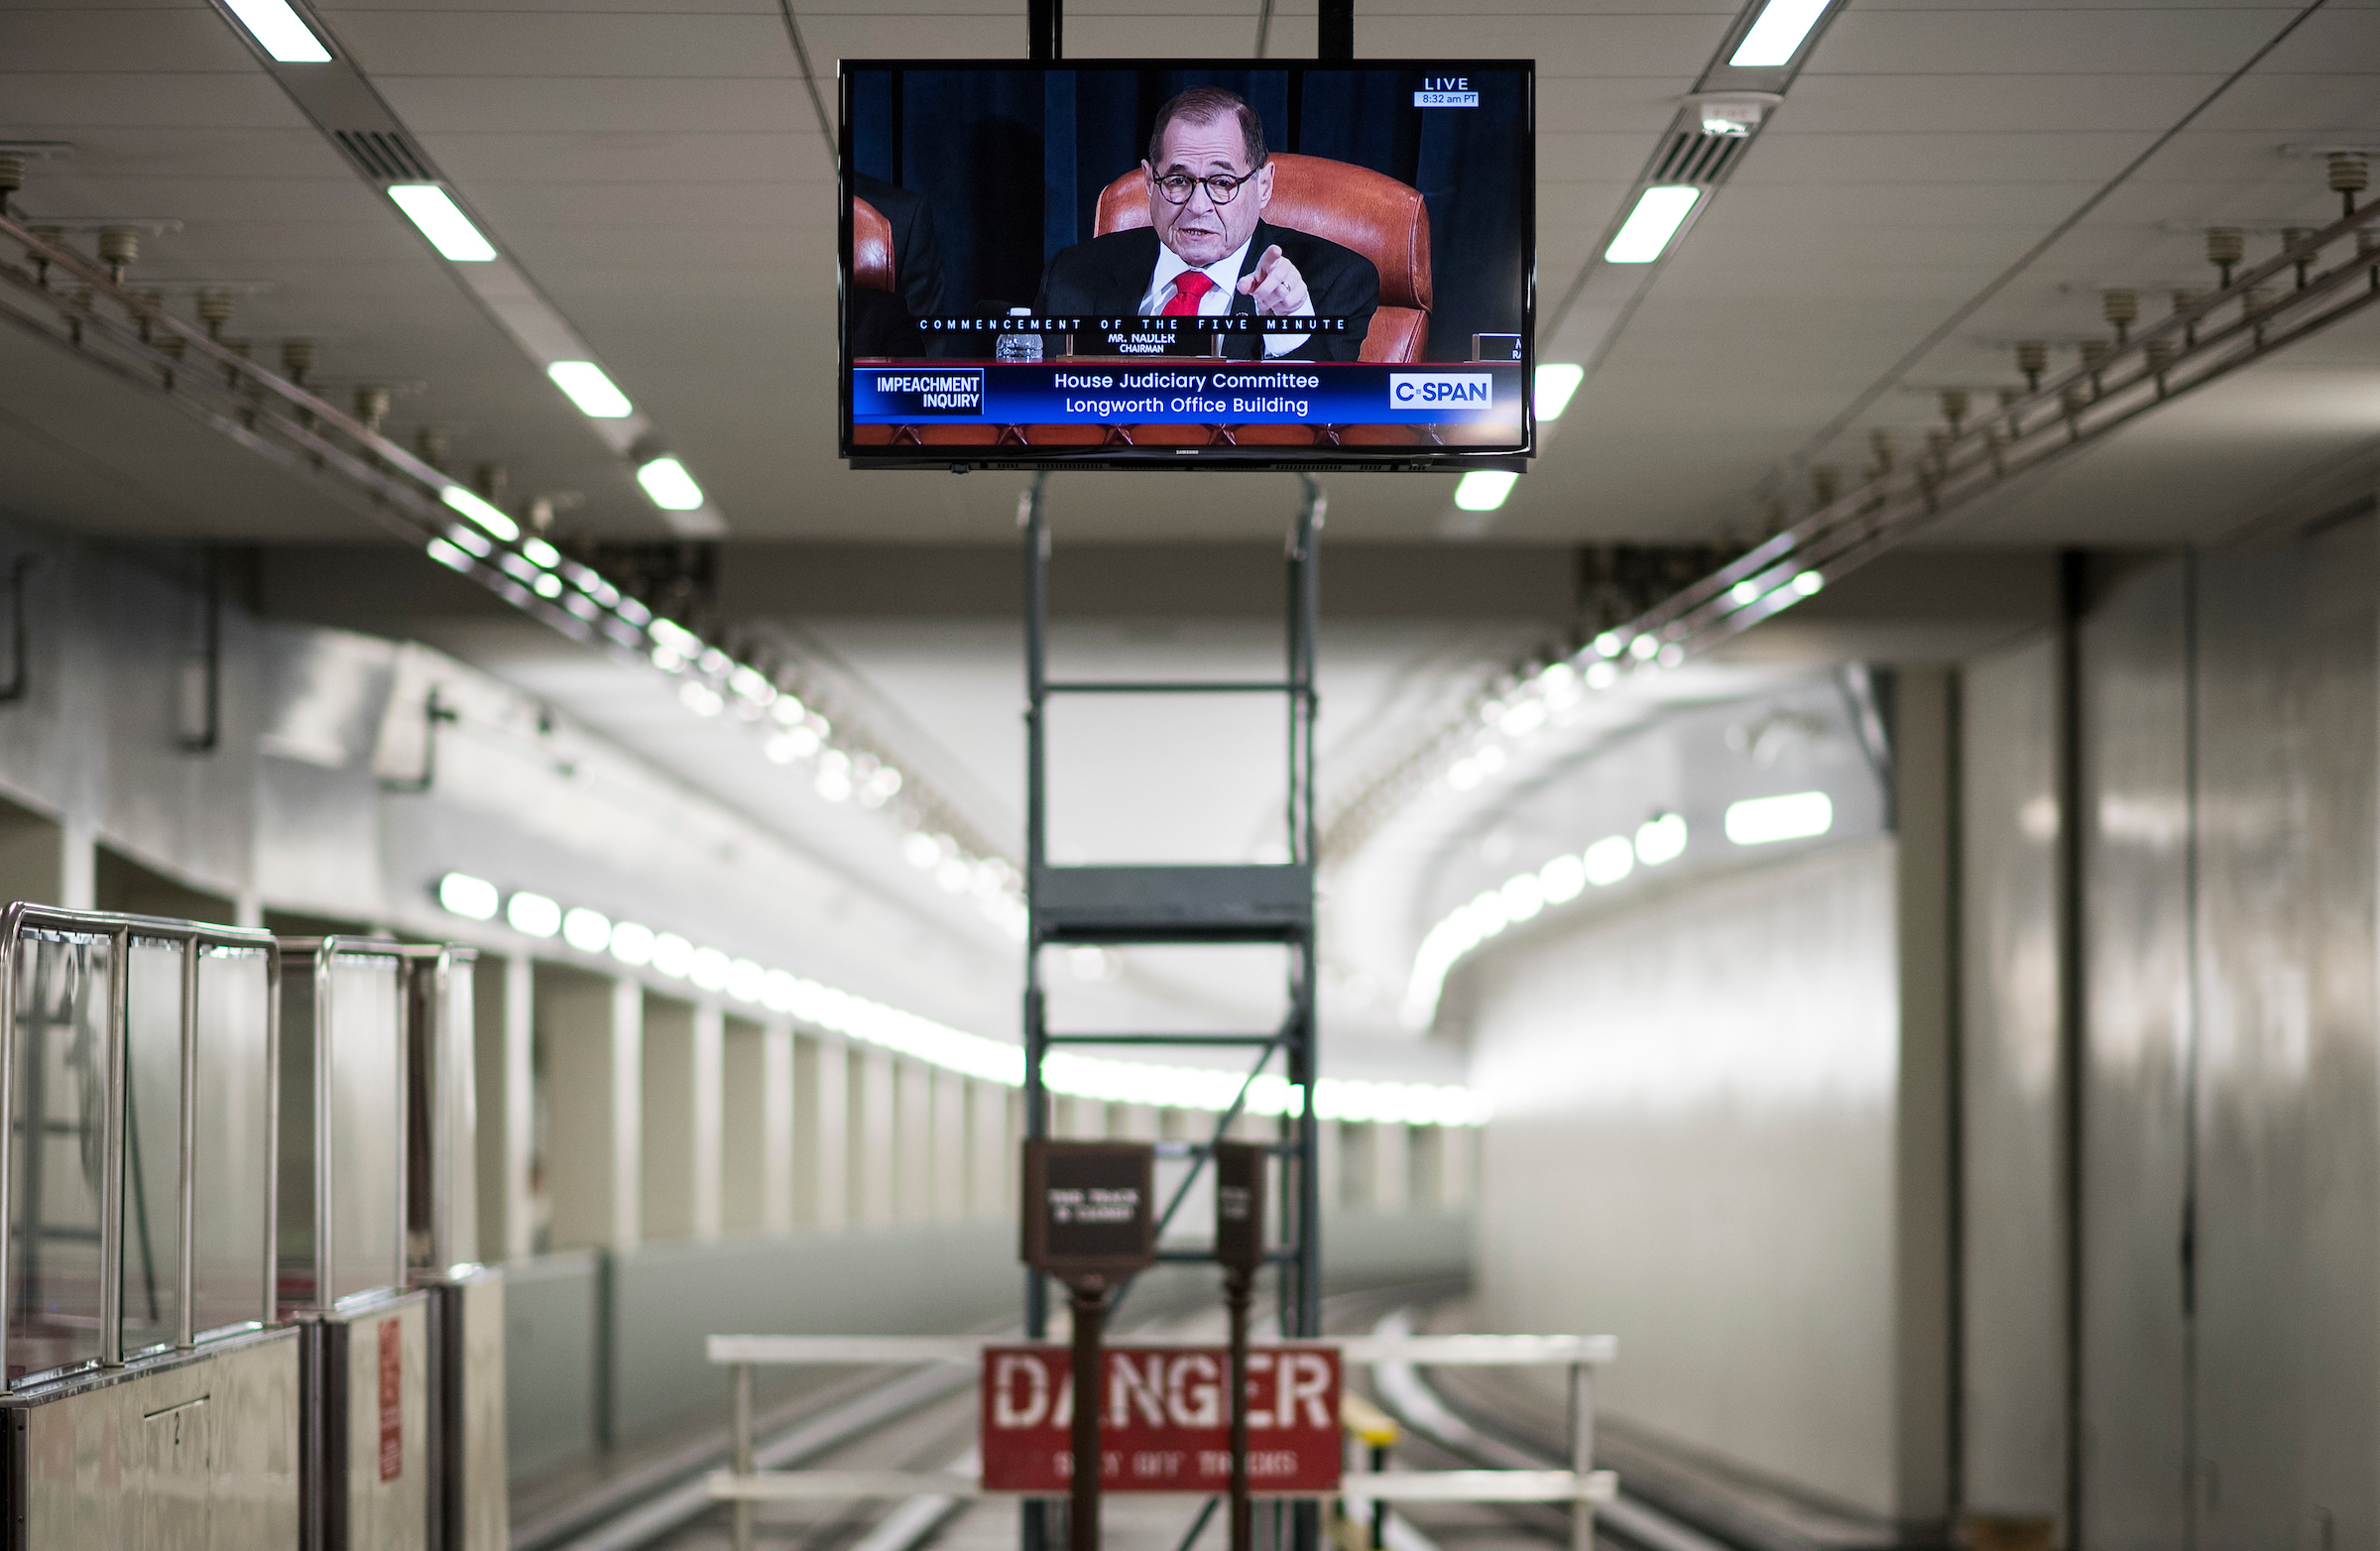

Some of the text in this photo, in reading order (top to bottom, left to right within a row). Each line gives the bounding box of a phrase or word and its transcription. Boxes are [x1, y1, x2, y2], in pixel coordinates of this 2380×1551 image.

[1425, 77, 1469, 90] LIVE
[1422, 94, 1445, 103] 8:32
[1464, 94, 1477, 103] PT
[919, 319, 1345, 330] COMMENCEMENT OF THE FIVE MINUTE
[1108, 334, 1175, 344] MR. NADLER
[1120, 344, 1164, 353] CHAIRMAN
[877, 377, 980, 393] IMPEACHMENT
[1055, 372, 1319, 393] House Judiciary Committee
[923, 394, 980, 409] INQUIRY
[1066, 397, 1308, 417] Longworth Office Building
